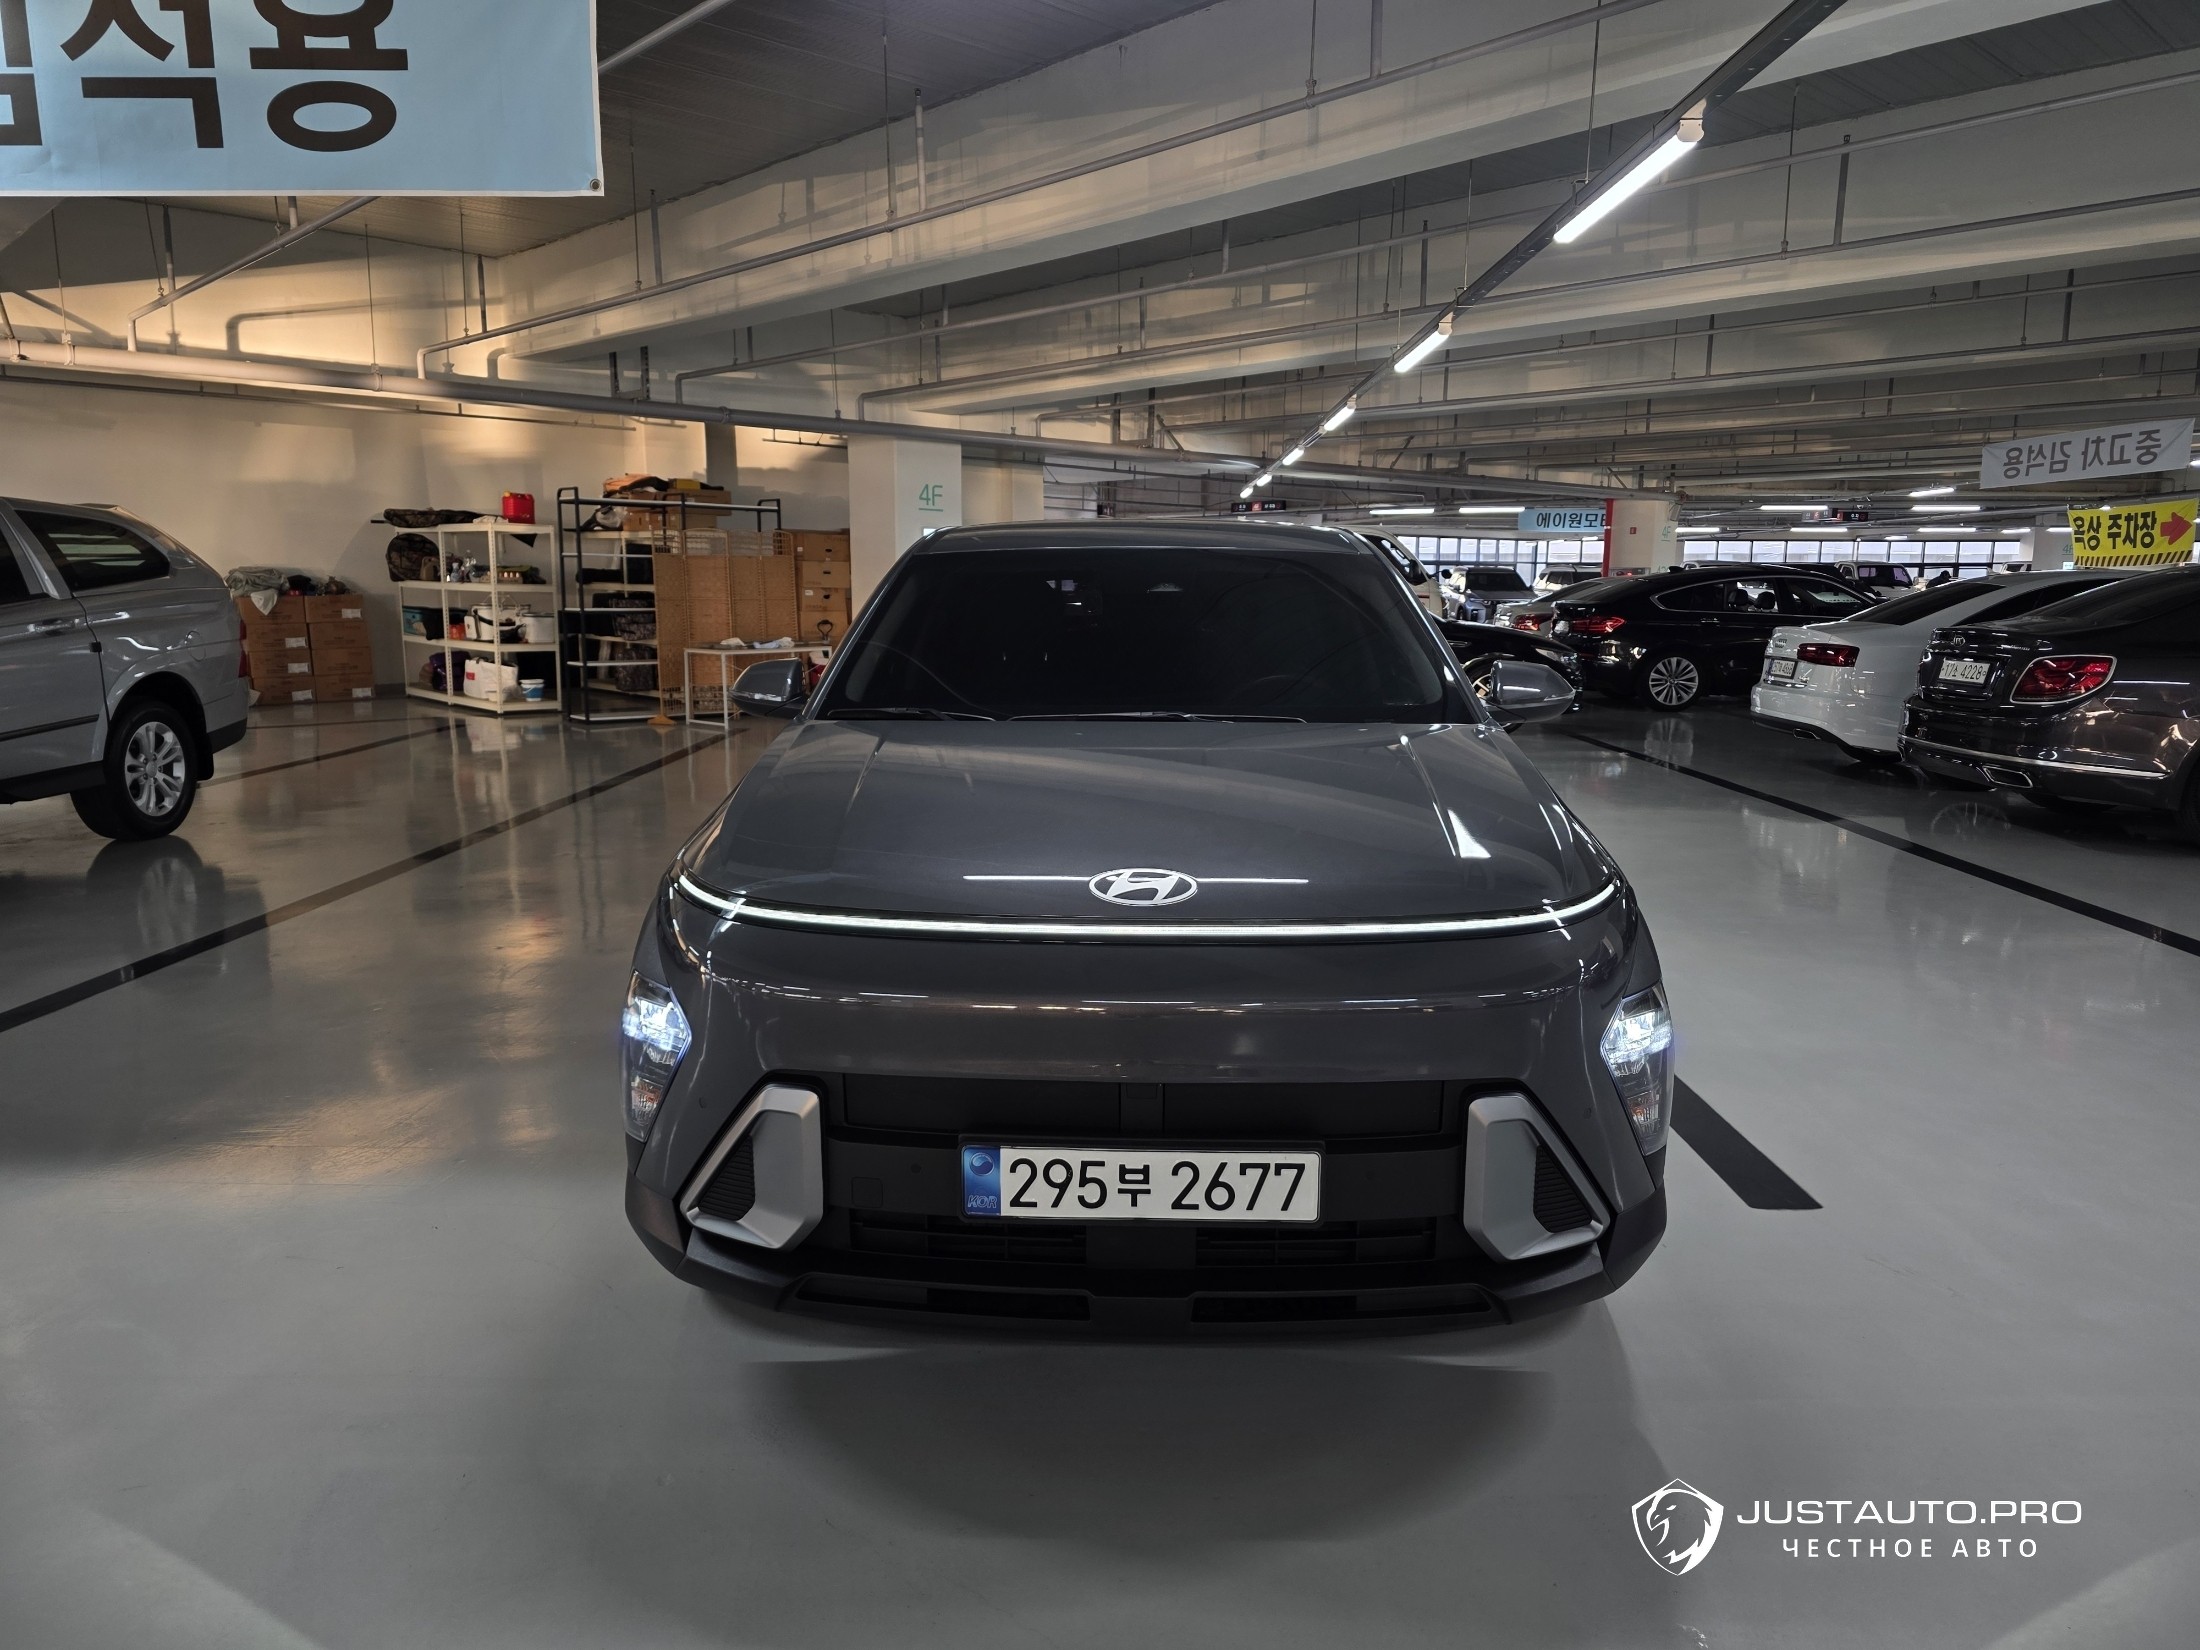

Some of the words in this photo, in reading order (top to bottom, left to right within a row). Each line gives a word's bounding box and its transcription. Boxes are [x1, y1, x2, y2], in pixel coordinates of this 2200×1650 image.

[919, 484, 943, 506] 4F
[2073, 515, 2102, 551] 옥상
[2107, 510, 2158, 549] 주차장
[1960, 664, 1984, 680] 4228
[1009, 1158, 1151, 1209] 295부
[1171, 1161, 1306, 1211] 2677
[967, 1194, 998, 1209] KOR
